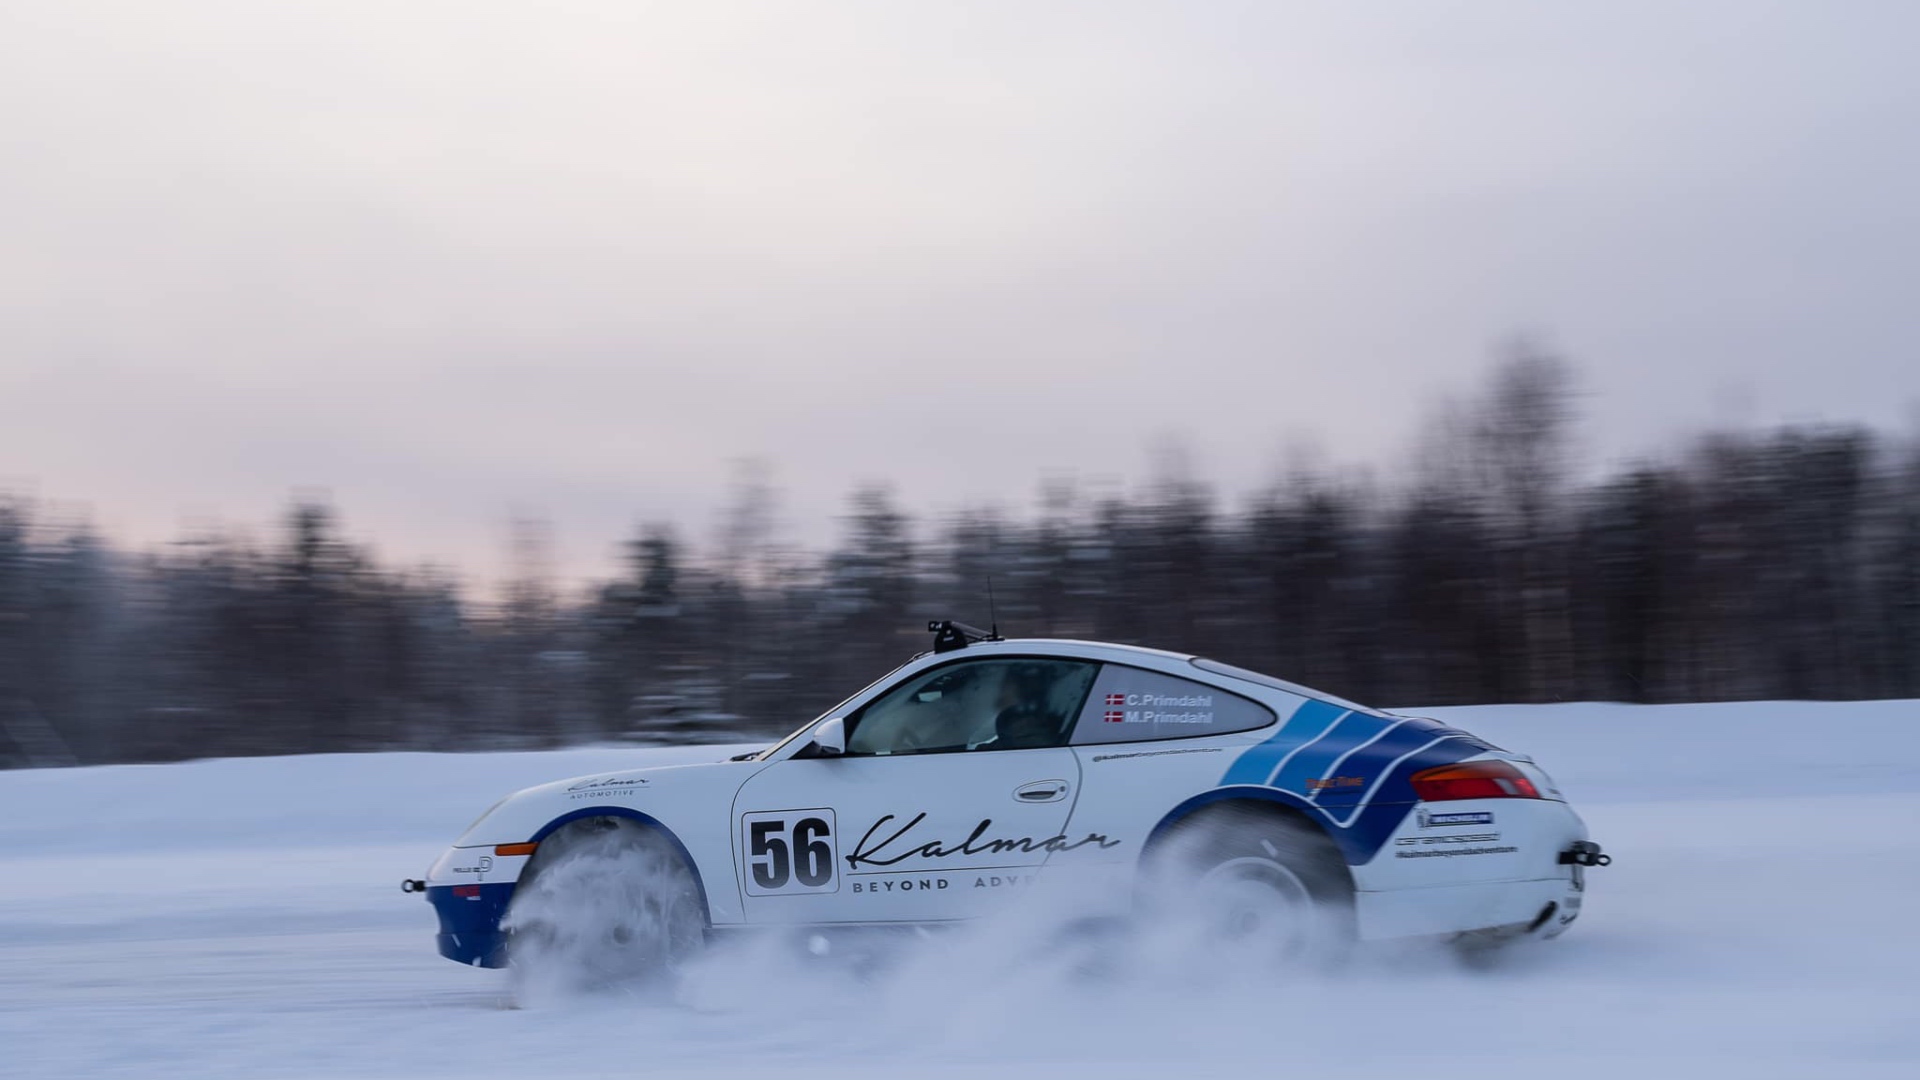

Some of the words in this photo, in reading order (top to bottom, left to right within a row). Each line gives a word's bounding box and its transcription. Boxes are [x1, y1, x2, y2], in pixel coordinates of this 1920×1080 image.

[1126, 694, 1213, 707] C.Primdahl
[1124, 711, 1214, 724] M.Primdahl
[569, 789, 635, 800] AUTOMOTIVE
[844, 811, 1122, 870] Kalmar
[750, 817, 833, 889] 56
[852, 877, 949, 893] BEYOND
